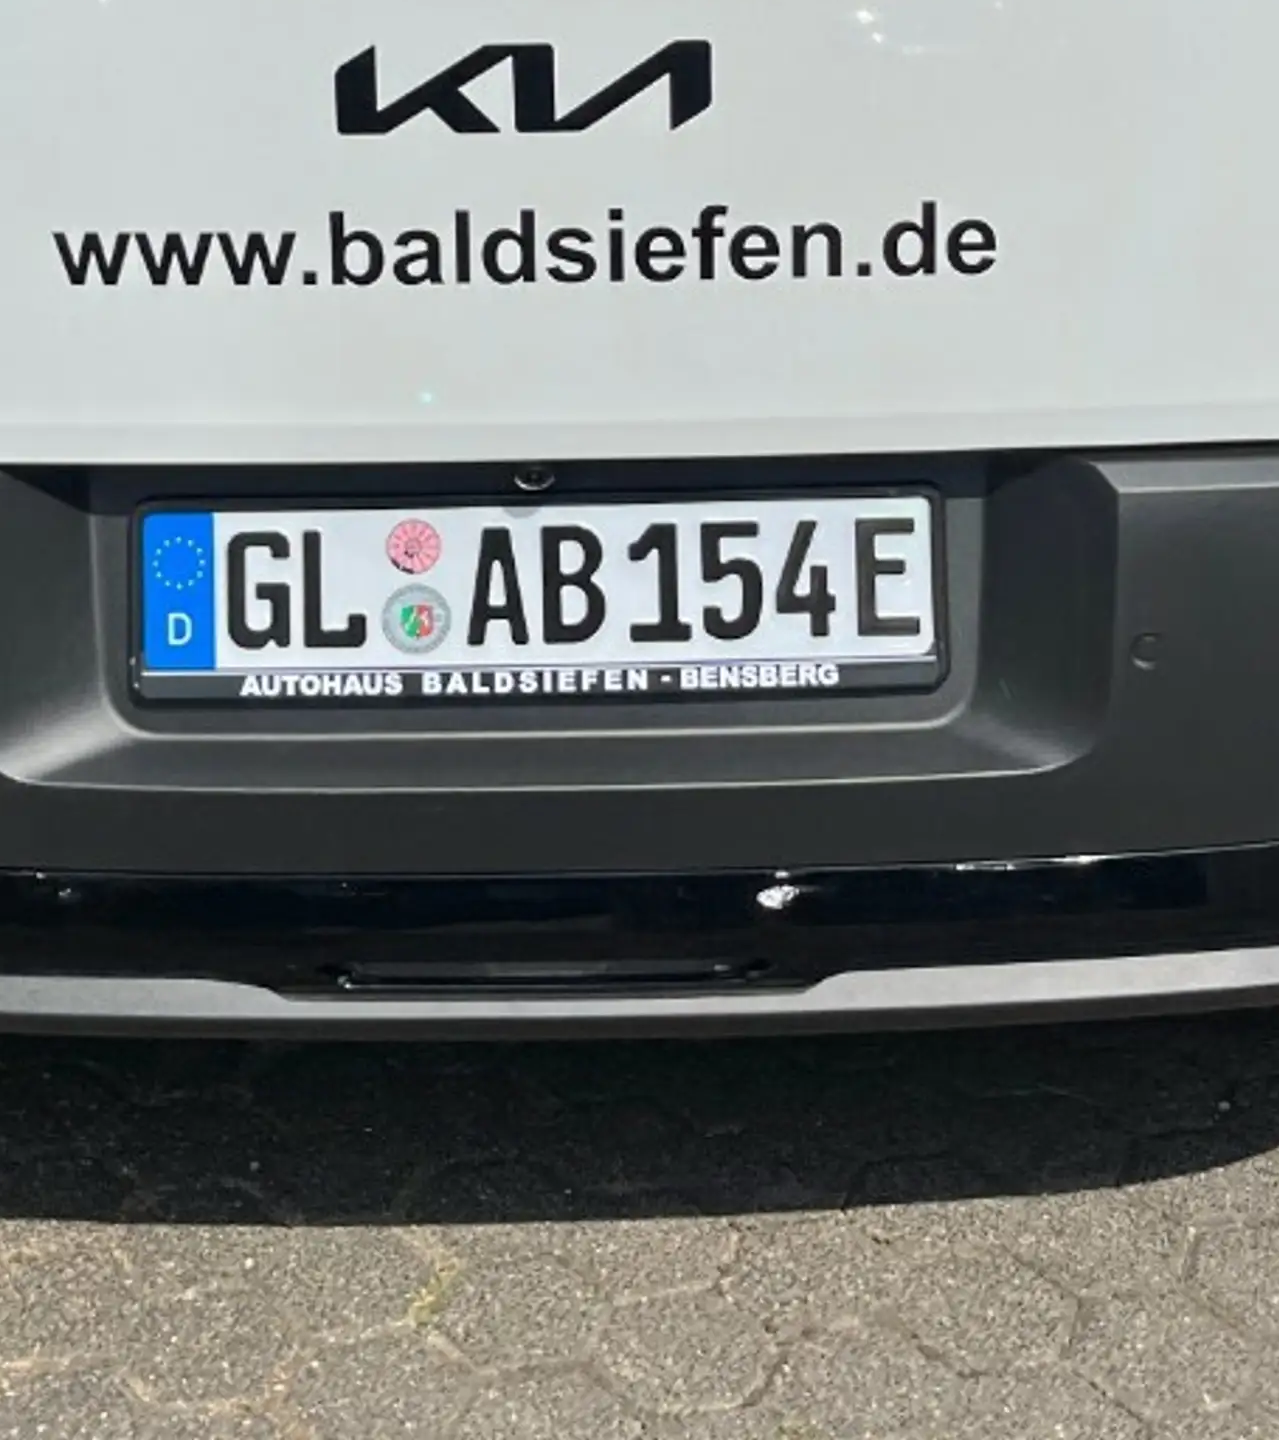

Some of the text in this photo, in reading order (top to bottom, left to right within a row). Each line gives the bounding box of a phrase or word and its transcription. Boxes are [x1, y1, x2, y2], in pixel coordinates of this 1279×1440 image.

[53, 201, 997, 286] www.baldsiefen.de
[227, 531, 367, 649] GL
[167, 611, 193, 646] D
[239, 673, 403, 697] AUTOHAUS
[422, 668, 648, 695] BALDSIEFEN
[680, 663, 840, 689] BENSBERG
